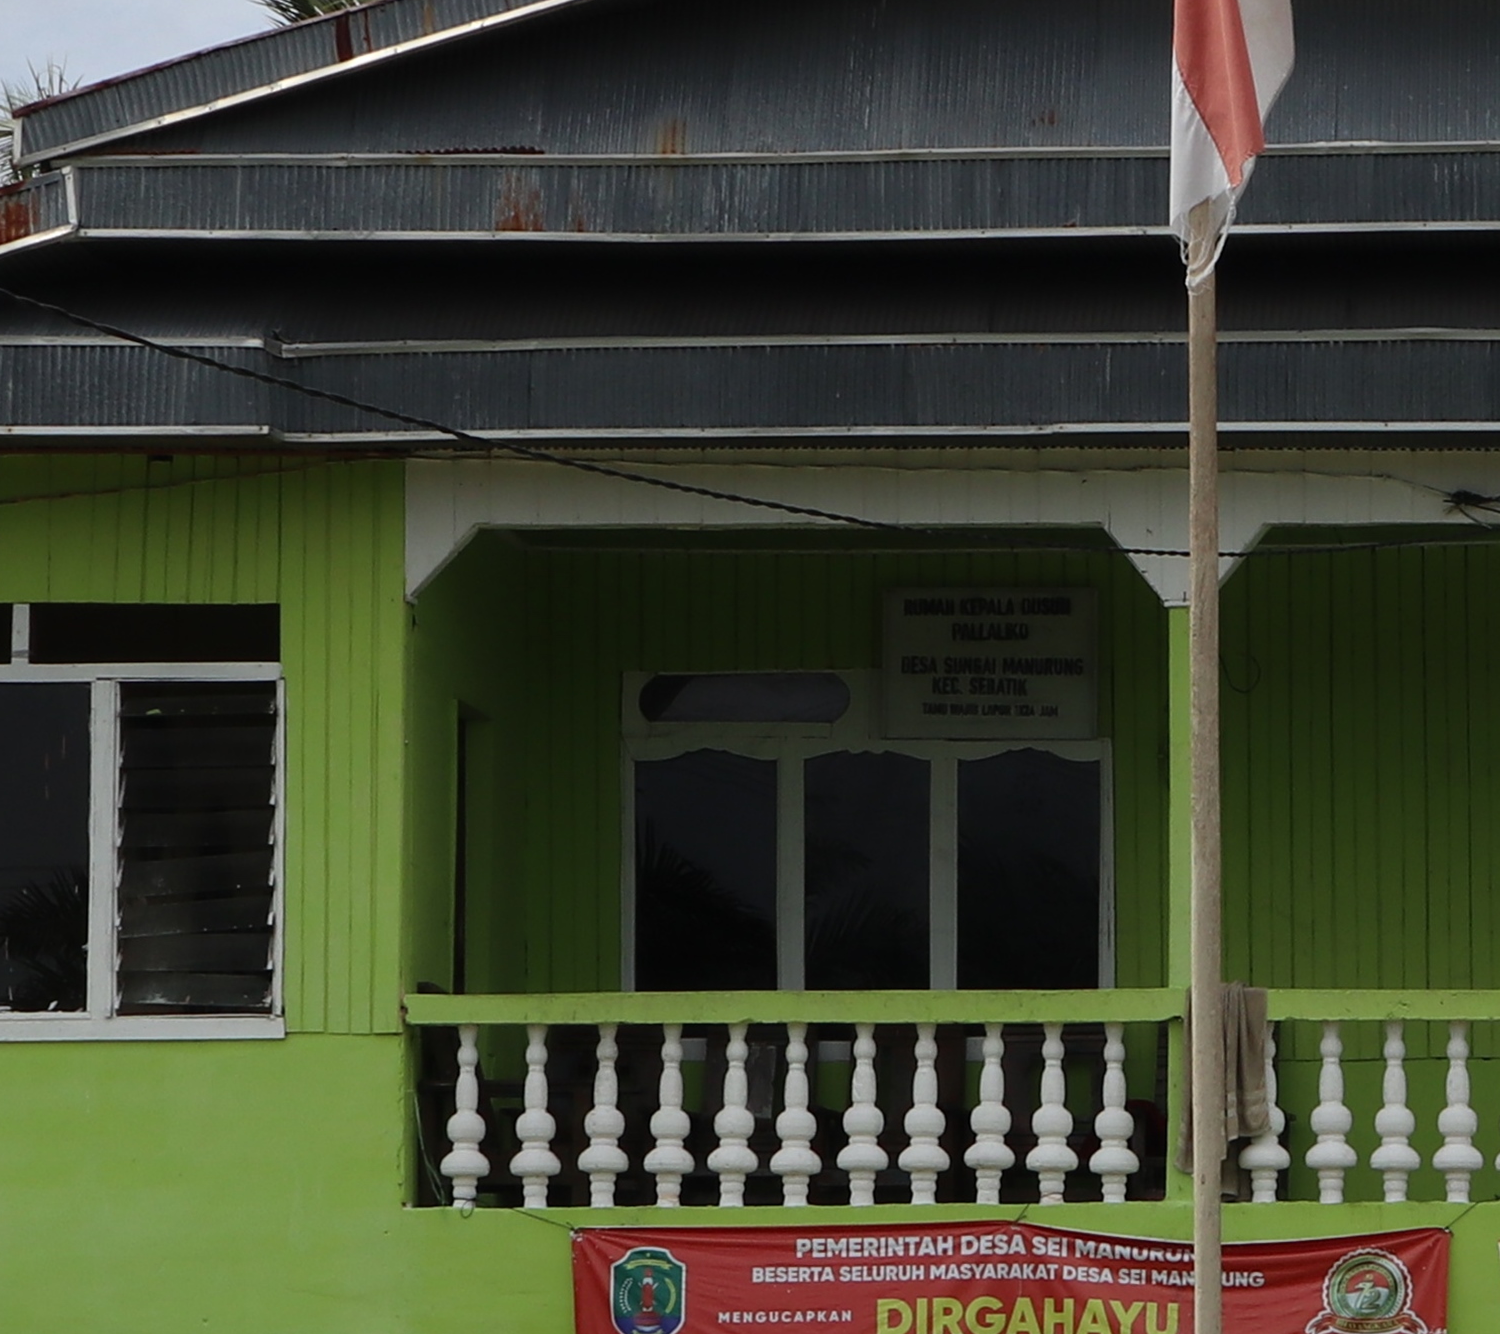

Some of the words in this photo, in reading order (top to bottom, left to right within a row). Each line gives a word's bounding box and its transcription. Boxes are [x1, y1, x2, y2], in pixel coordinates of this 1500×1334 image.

[960, 598, 1014, 615] KEPALA
[901, 656, 937, 673] DESA
[944, 657, 996, 673] SUNGAI
[1003, 657, 1083, 675] MANURUNG
[932, 678, 963, 695] KEC.
[969, 678, 1027, 696] SEBATIK
[796, 1236, 957, 1259] PEMERINTAH
[961, 1237, 1027, 1258] DESA
[1031, 1238, 1070, 1259] SEI
[752, 1266, 835, 1284] BESERTA
[839, 1266, 926, 1284] SELURUH
[929, 1264, 1059, 1284] MASYARAKAT
[1063, 1266, 1116, 1286] DESA
[1119, 1270, 1148, 1288] SEI
[1152, 1272, 1265, 1290] MANUNG
[718, 1309, 853, 1325] MENGUCAPKAN
